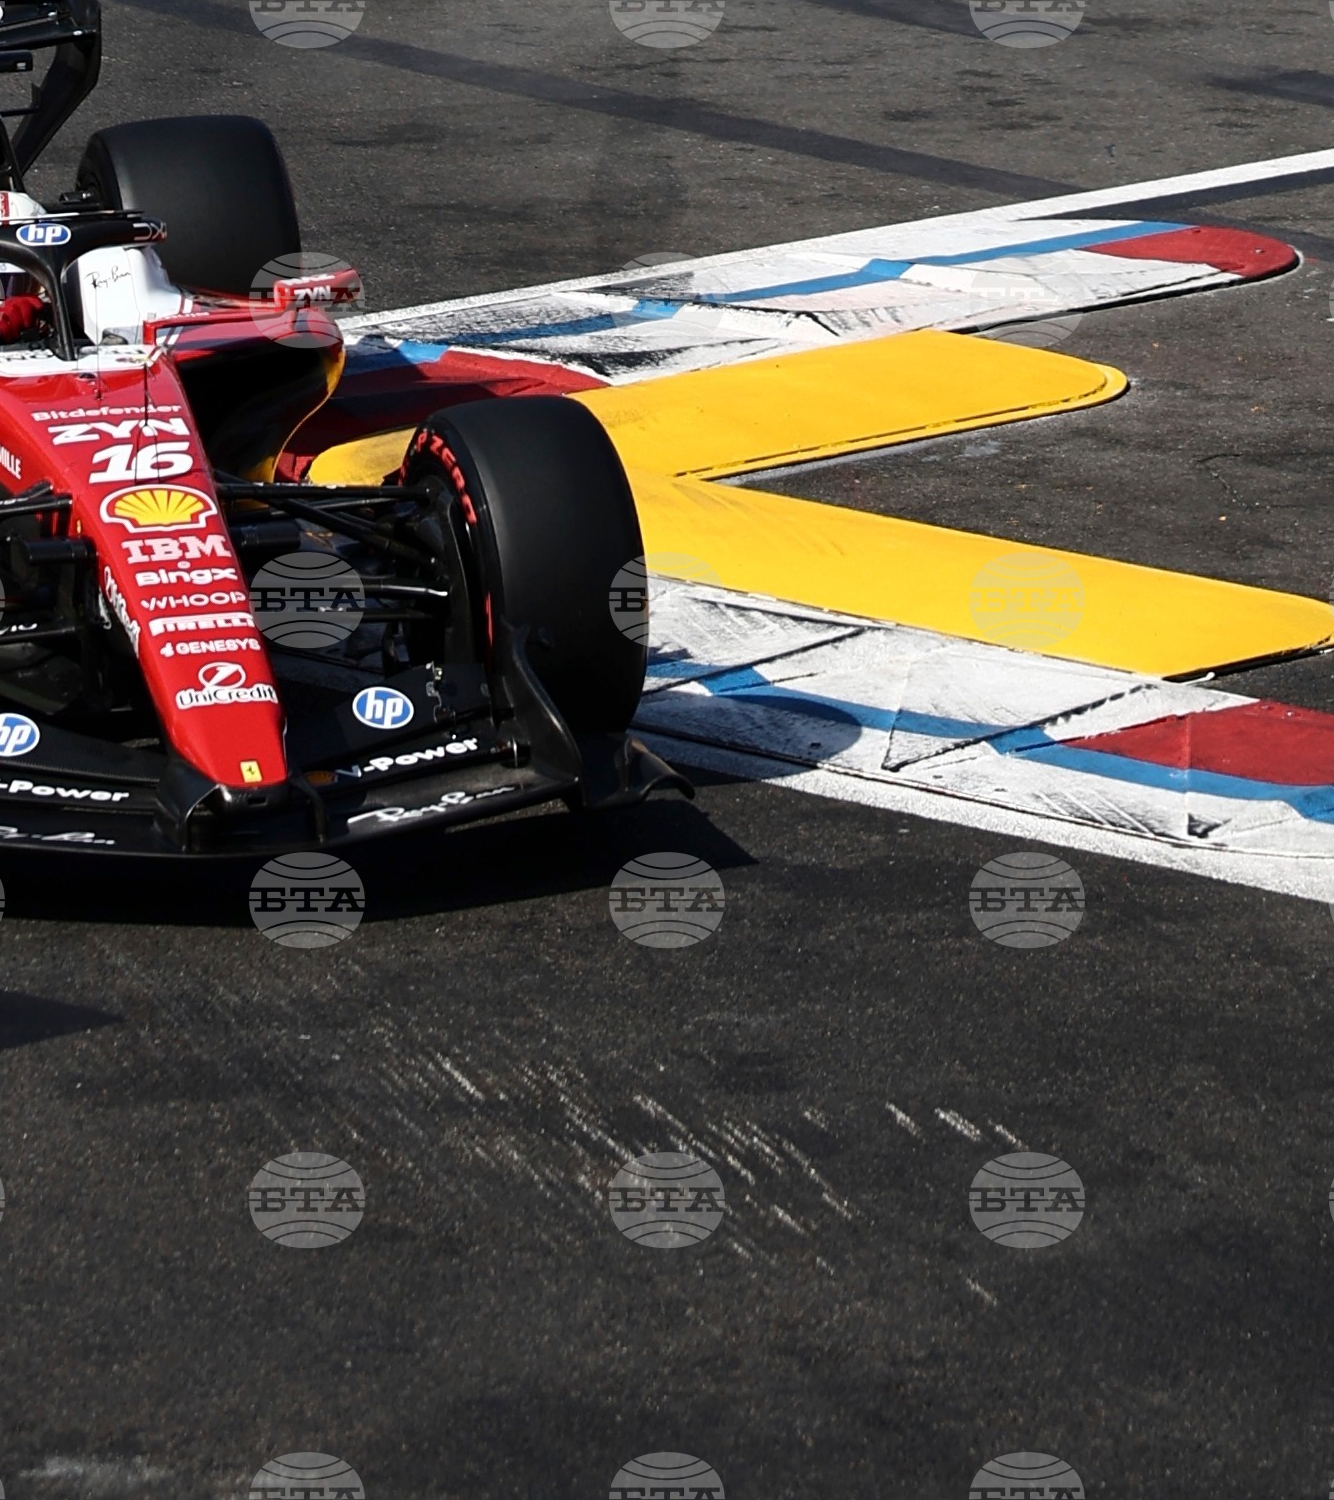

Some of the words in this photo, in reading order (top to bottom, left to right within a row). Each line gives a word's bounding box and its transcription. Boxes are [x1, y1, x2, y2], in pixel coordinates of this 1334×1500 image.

[293, 285, 332, 303] ZYN
[31, 404, 183, 422] Bitdefender
[48, 417, 191, 446] ZYN
[89, 441, 194, 484] 16
[429, 433, 478, 525] ZERO
[121, 534, 232, 564] IBM
[140, 591, 247, 611] WHOOP
[176, 638, 261, 655] GENESYS
[178, 685, 277, 708] UniCredit
[364, 688, 404, 728] hp
[335, 736, 479, 781] V-Power
